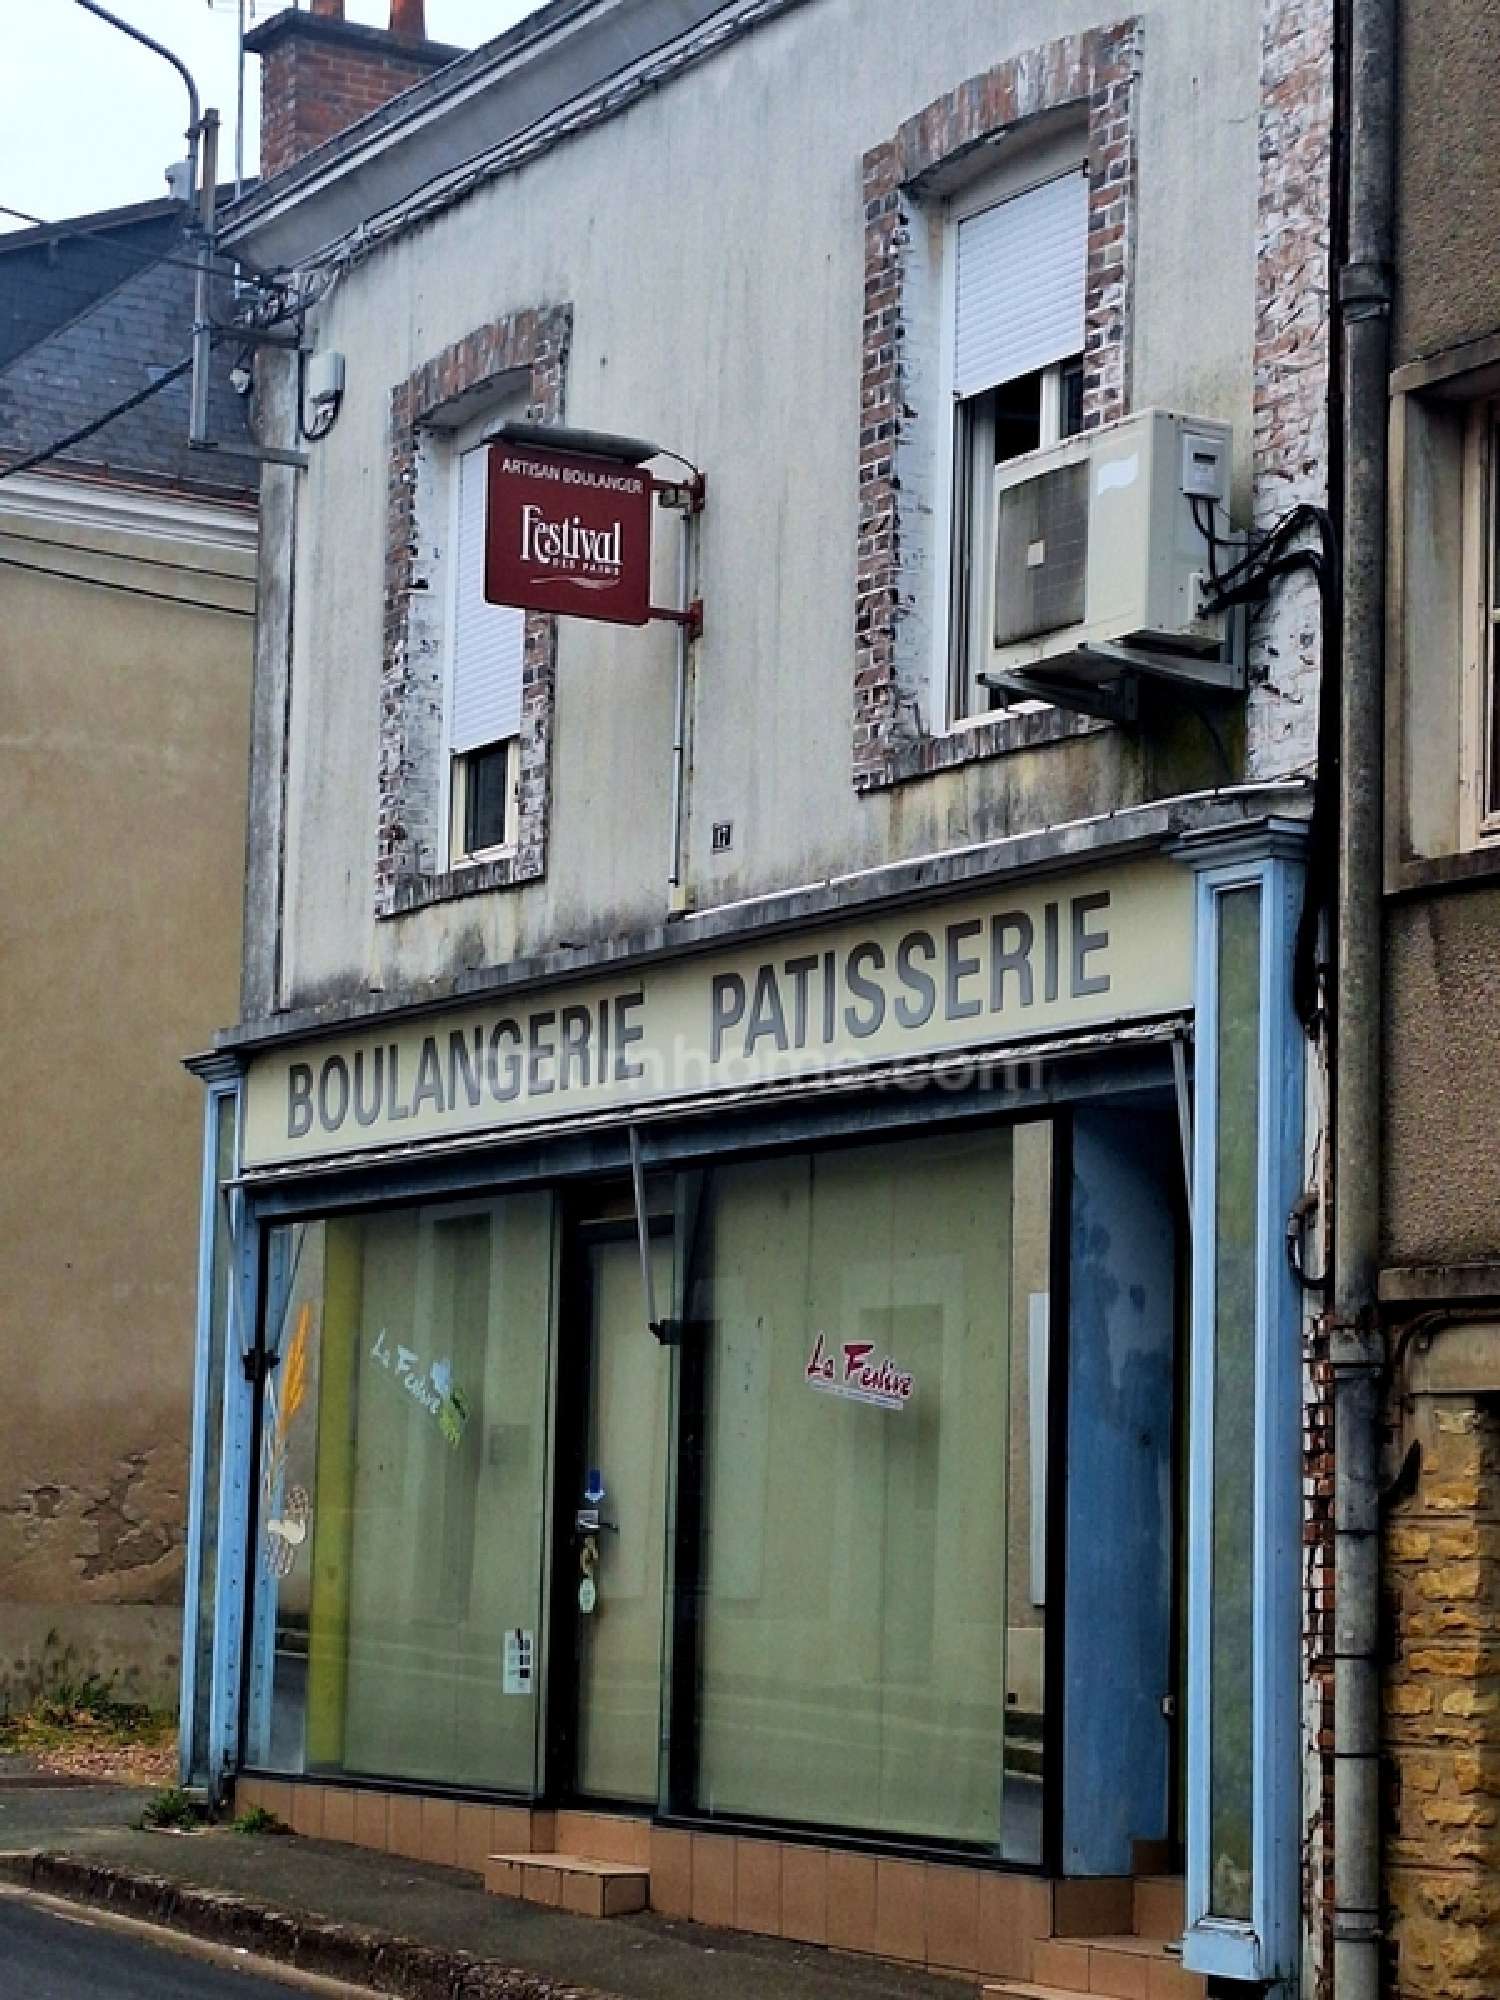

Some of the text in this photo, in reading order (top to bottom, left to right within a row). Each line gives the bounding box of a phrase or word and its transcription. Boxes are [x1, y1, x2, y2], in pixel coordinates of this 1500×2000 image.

[502, 458, 645, 494] ARTISAN BOULANGER
[520, 504, 623, 564] Festival
[288, 890, 1111, 1139] BOULANGERIE PATISSERIE
[806, 1331, 834, 1379] La
